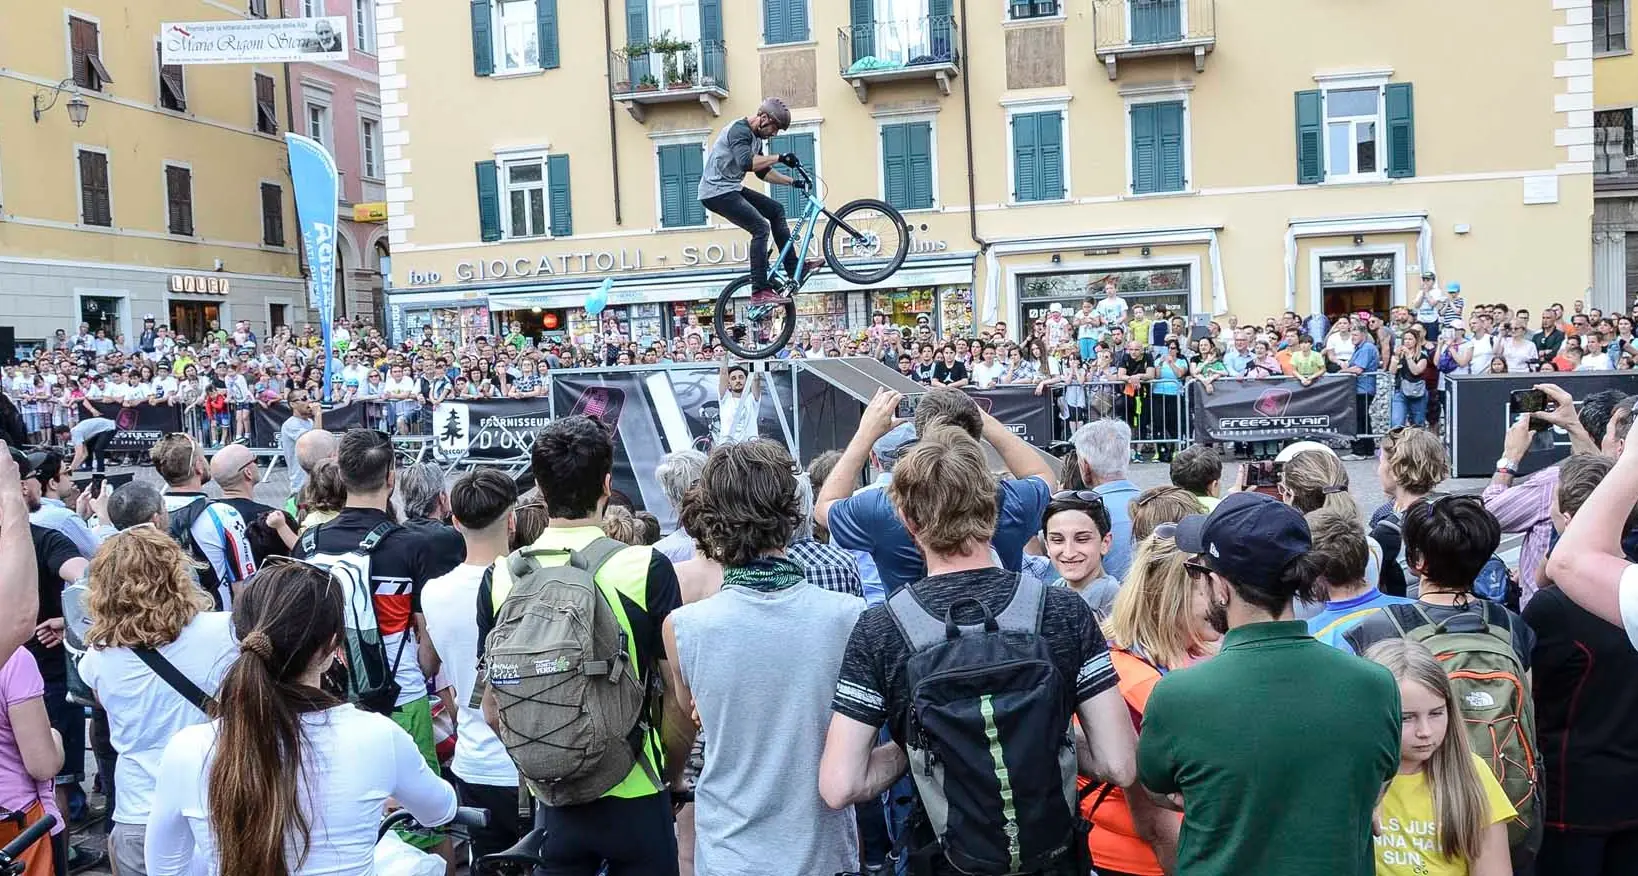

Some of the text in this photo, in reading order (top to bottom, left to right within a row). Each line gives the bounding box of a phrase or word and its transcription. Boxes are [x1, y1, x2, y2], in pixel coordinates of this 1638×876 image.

[166, 32, 310, 56] Mario Rigoni Stern
[408, 268, 441, 285] foto
[455, 248, 642, 281] GIOCATTOLI
[170, 274, 229, 294] LAURA
[480, 417, 550, 427] FOURNISSEUR
[479, 430, 541, 450] D'OXY
[1404, 820, 1436, 836] JUS
[1372, 834, 1438, 851] NNA HA
